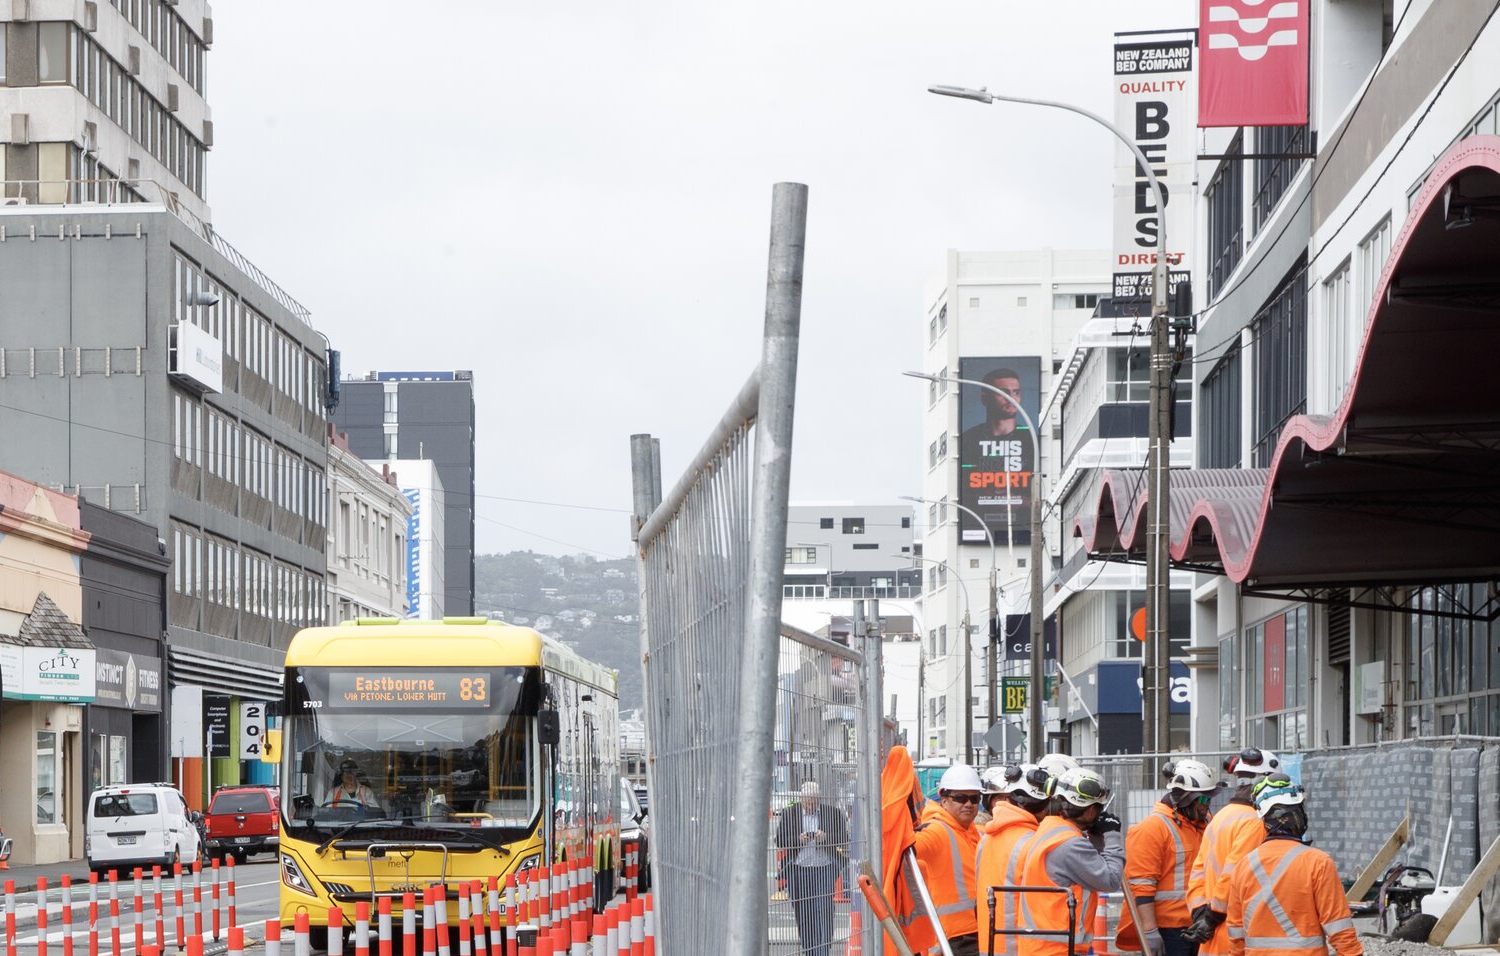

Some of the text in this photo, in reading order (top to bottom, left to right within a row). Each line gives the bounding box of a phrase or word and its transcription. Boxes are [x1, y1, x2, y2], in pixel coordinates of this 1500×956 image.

[1116, 47, 1190, 61] NEW ZEALAND
[1116, 58, 1190, 72] BED COMPANY
[1119, 80, 1186, 94] QUALITY
[1135, 101, 1170, 247] BEDS
[1115, 273, 1189, 286] NEW ZEAND
[1114, 285, 1136, 297] BED
[979, 440, 1022, 456] THIS
[1004, 456, 1022, 472] IS
[969, 472, 1032, 488] SPORT
[38, 655, 80, 672] CITY
[97, 662, 159, 690] INSTINCT FITNESS
[344, 692, 358, 701] VIA
[397, 692, 426, 701] LOWER
[427, 692, 446, 701] HUTT
[355, 676, 486, 701] Eastbourne 83
[246, 706, 260, 755] 204
